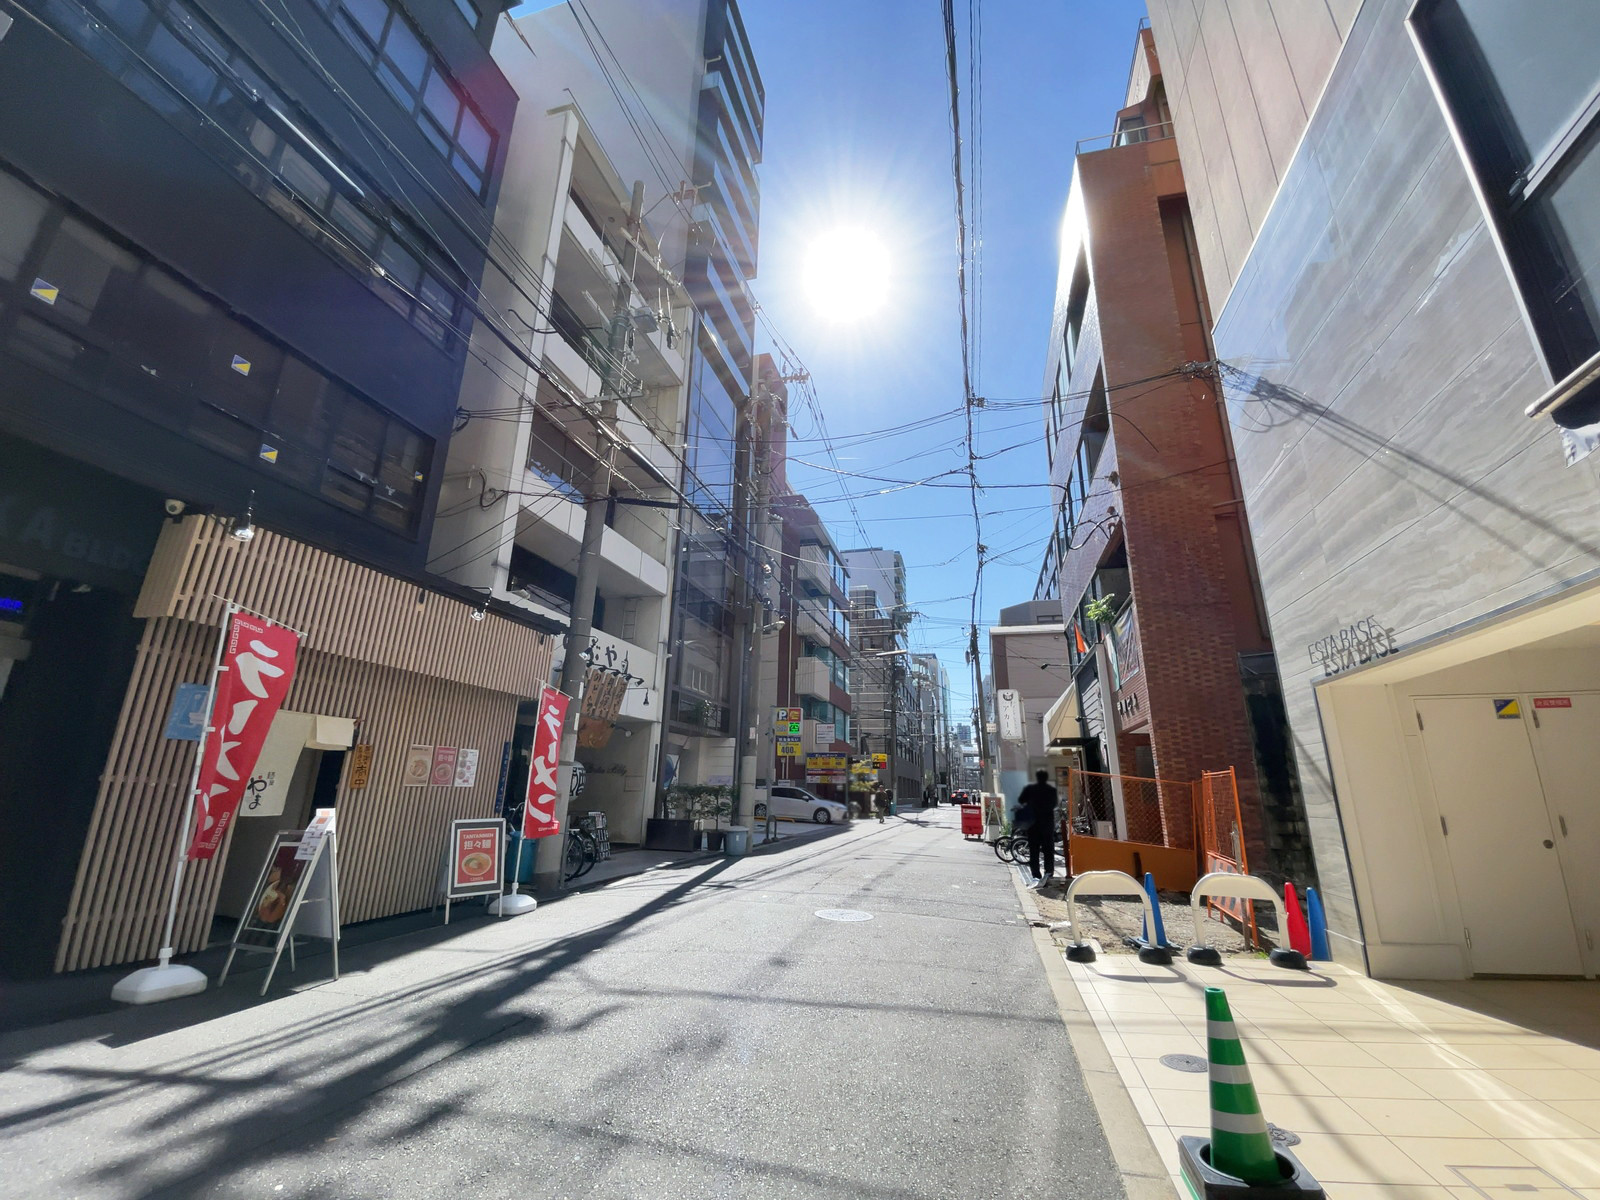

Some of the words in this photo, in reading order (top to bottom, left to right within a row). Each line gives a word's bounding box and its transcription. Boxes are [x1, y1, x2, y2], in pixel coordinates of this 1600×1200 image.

[1308, 634, 1342, 664] ESTA
[1339, 615, 1377, 652] BASE
[528, 704, 561, 824] ラーメン
